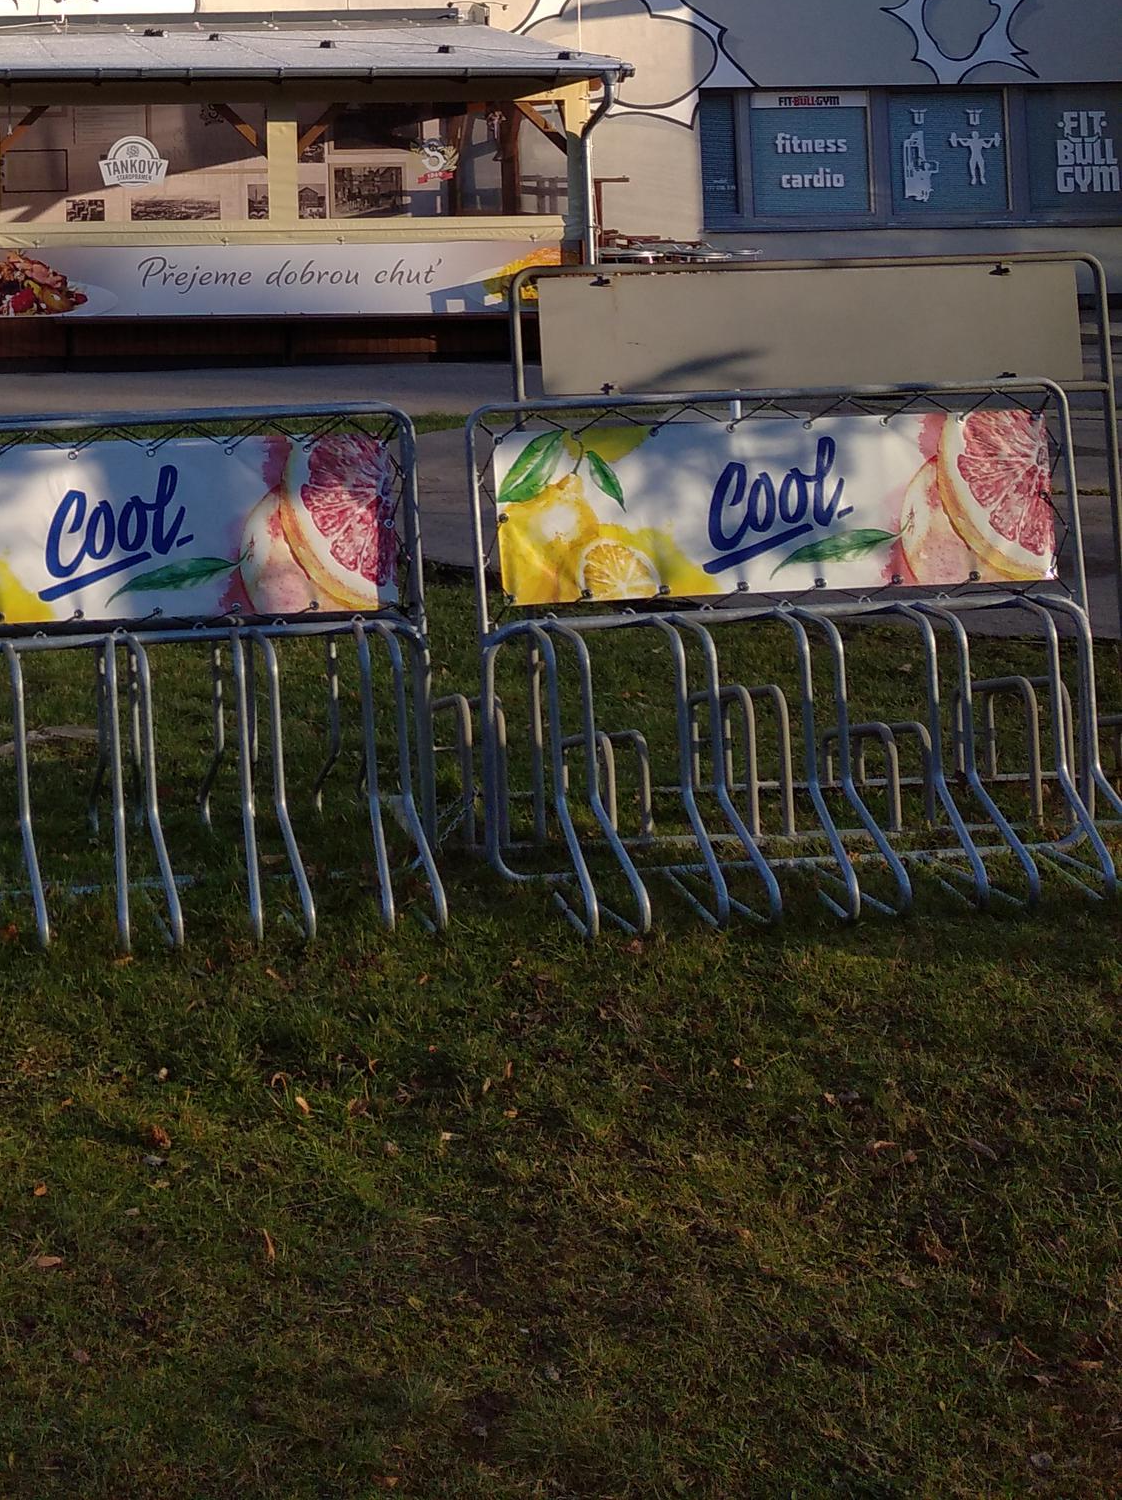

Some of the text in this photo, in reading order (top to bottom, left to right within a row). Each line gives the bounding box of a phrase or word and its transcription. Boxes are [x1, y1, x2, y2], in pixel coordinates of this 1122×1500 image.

[775, 132, 848, 154] fitness
[1056, 138, 1118, 166] BULL
[104, 159, 163, 176] TANKOVÝ
[781, 167, 845, 189] cardio
[1056, 165, 1120, 193] GYM
[137, 256, 444, 295] Přejeme dobrou chuť
[708, 436, 846, 551] Cool
[45, 464, 187, 579] Cool
